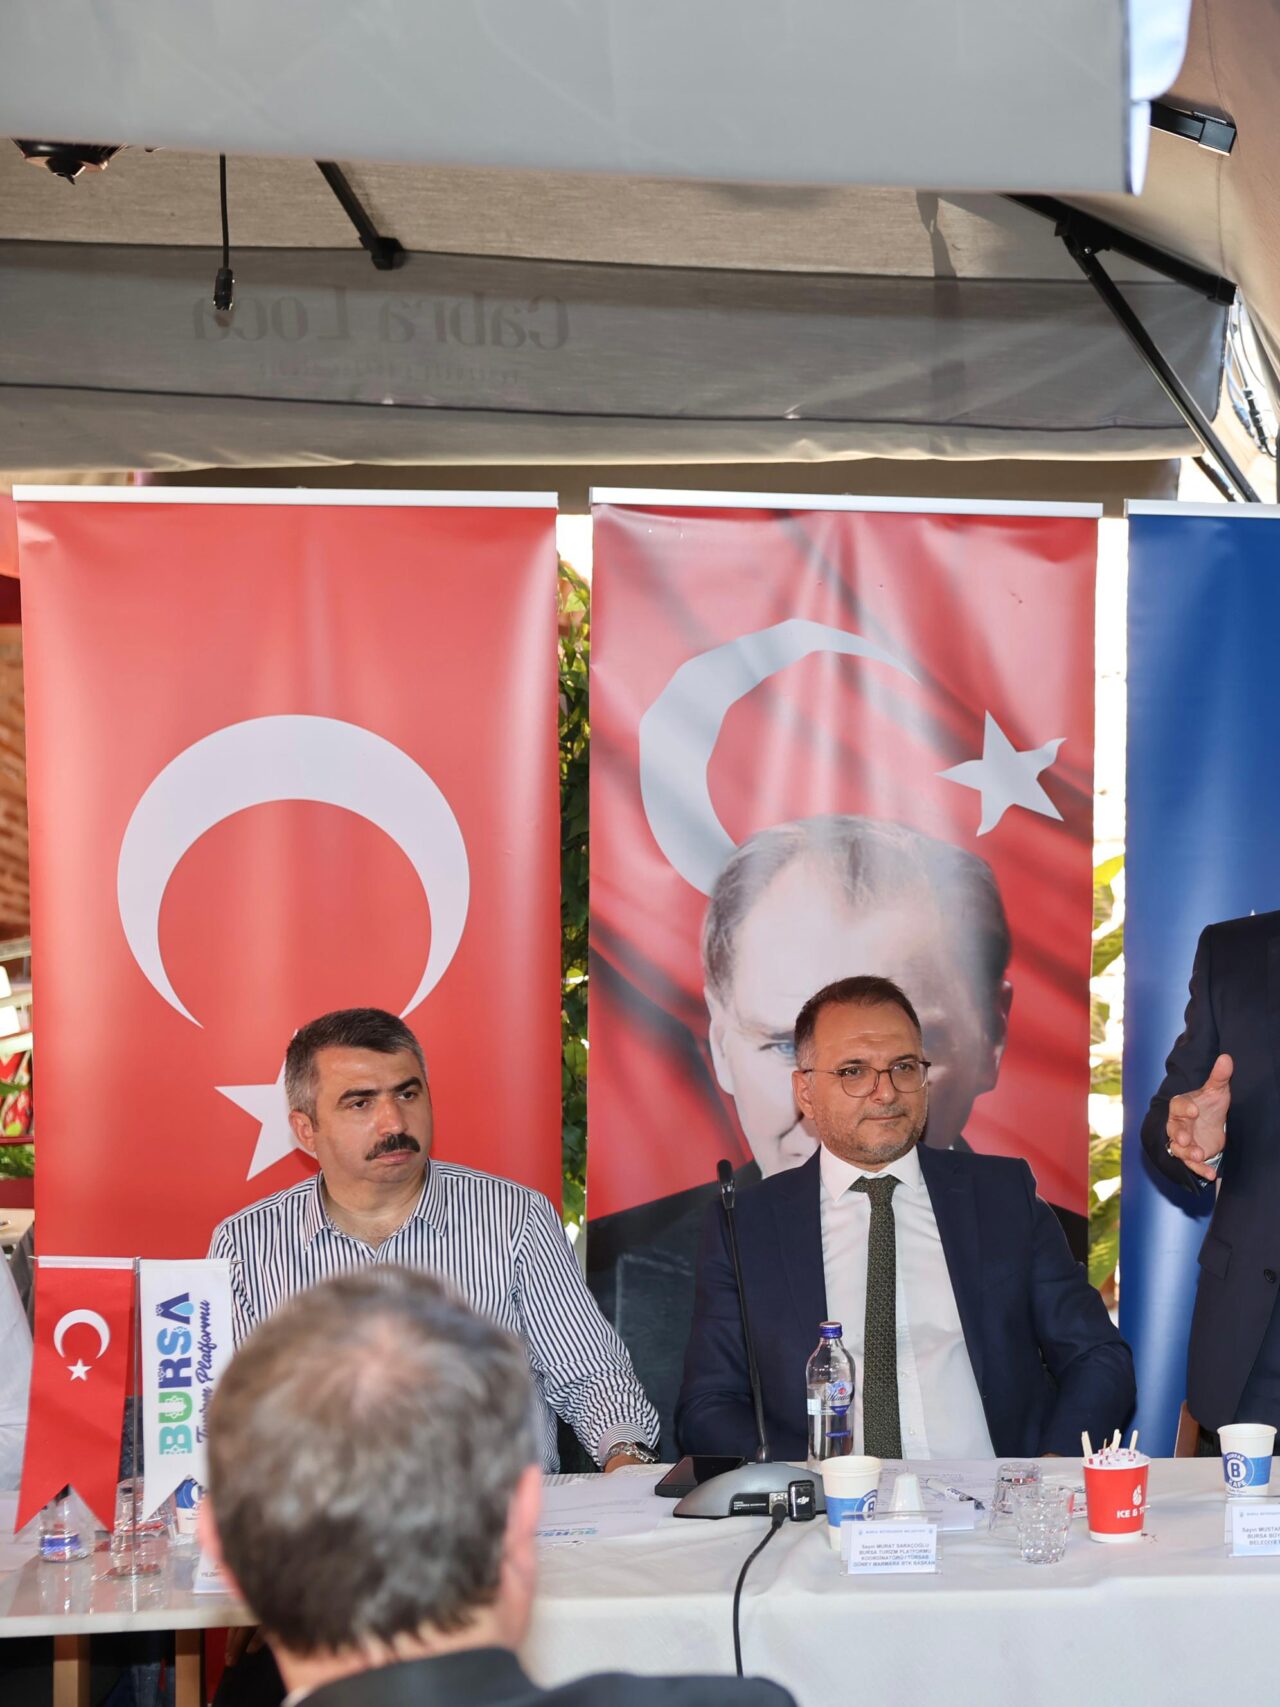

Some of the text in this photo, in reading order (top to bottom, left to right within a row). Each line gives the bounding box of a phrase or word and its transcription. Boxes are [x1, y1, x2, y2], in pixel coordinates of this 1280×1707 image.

[155, 1292, 195, 1456] BURSA
[195, 1299, 217, 1384] Platformu
[1230, 1462, 1241, 1478] B
